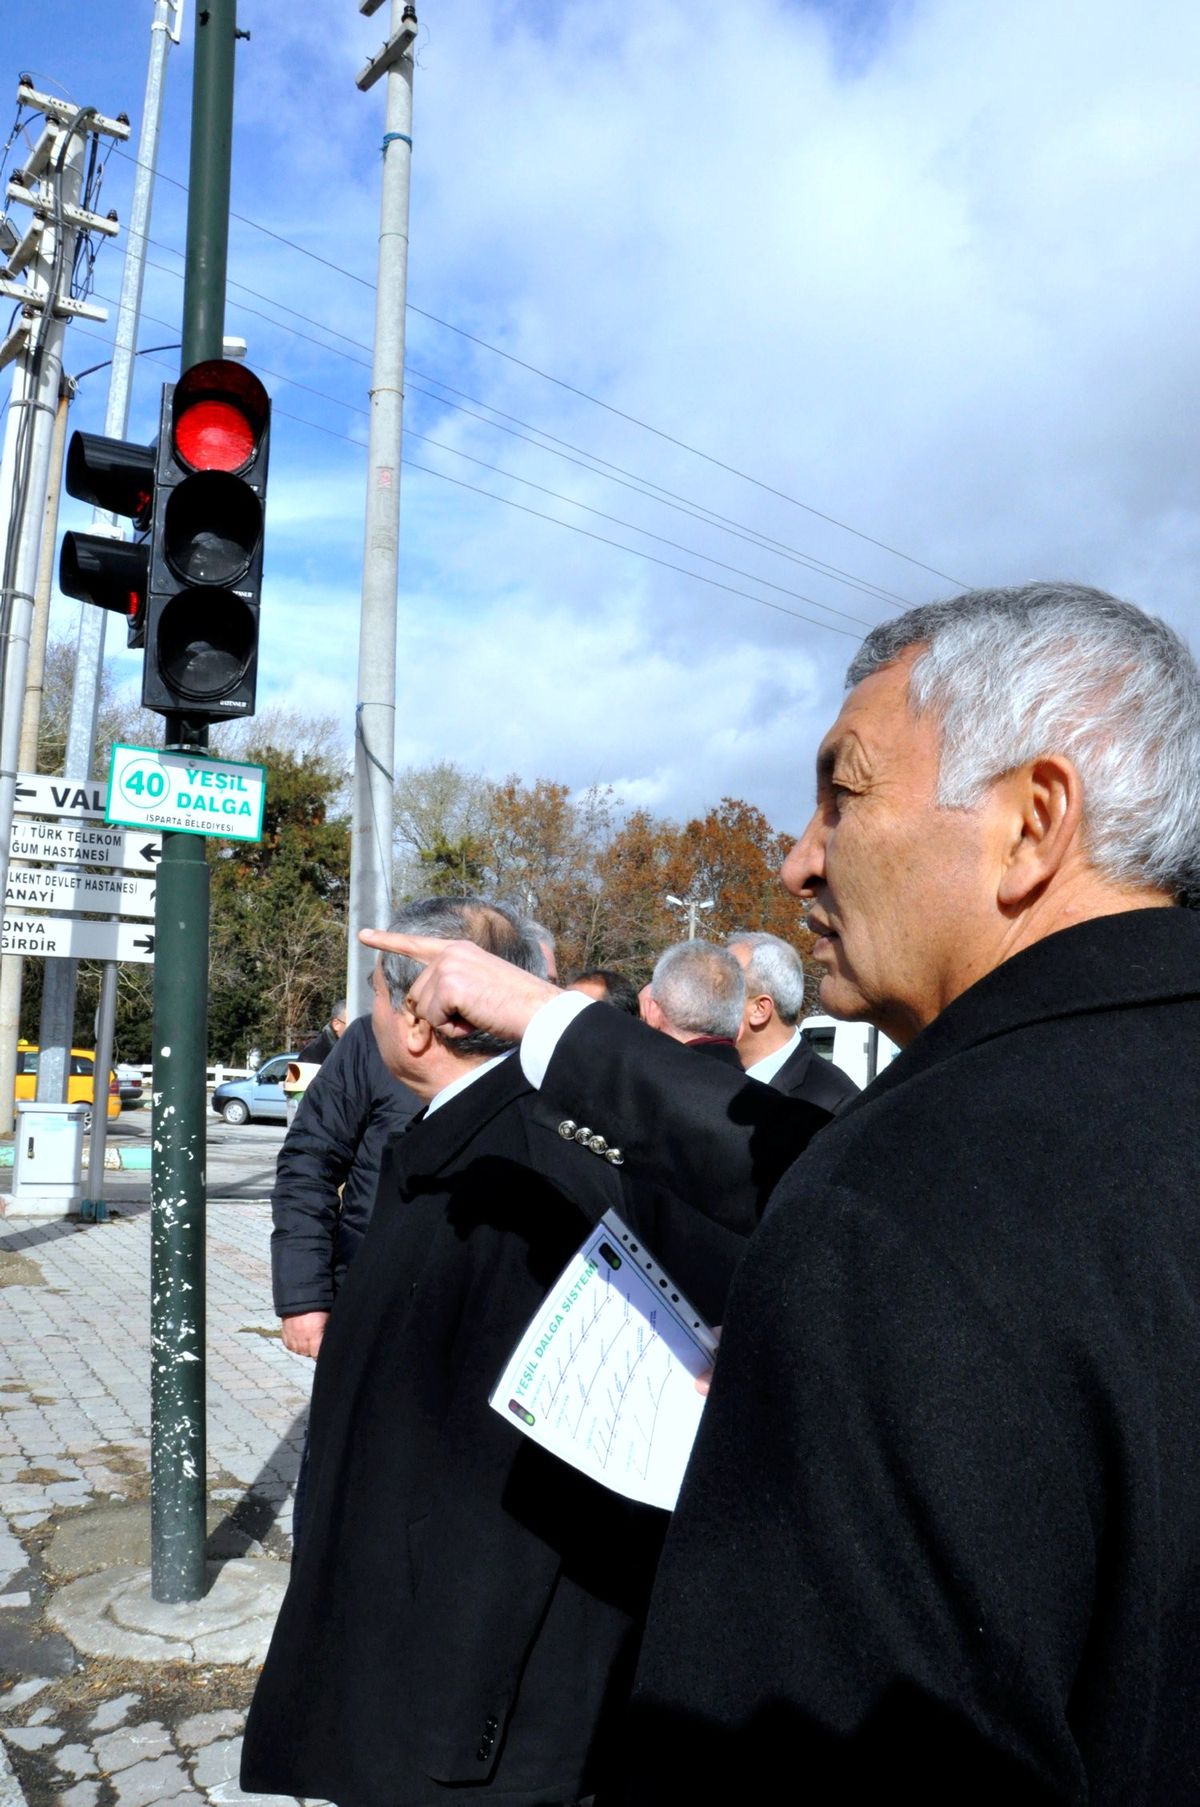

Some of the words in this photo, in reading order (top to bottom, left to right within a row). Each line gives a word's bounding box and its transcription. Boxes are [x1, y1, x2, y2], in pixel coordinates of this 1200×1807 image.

[125, 770, 165, 798] 40
[177, 792, 252, 817] DALGA
[30, 824, 63, 840] TÜRK
[67, 831, 122, 846] TELEKOM
[43, 845, 109, 861] HASTANESİ
[45, 875, 82, 889] DEVLET
[84, 878, 138, 894] HASTANESİ
[534, 1313, 564, 1358] DALGA
